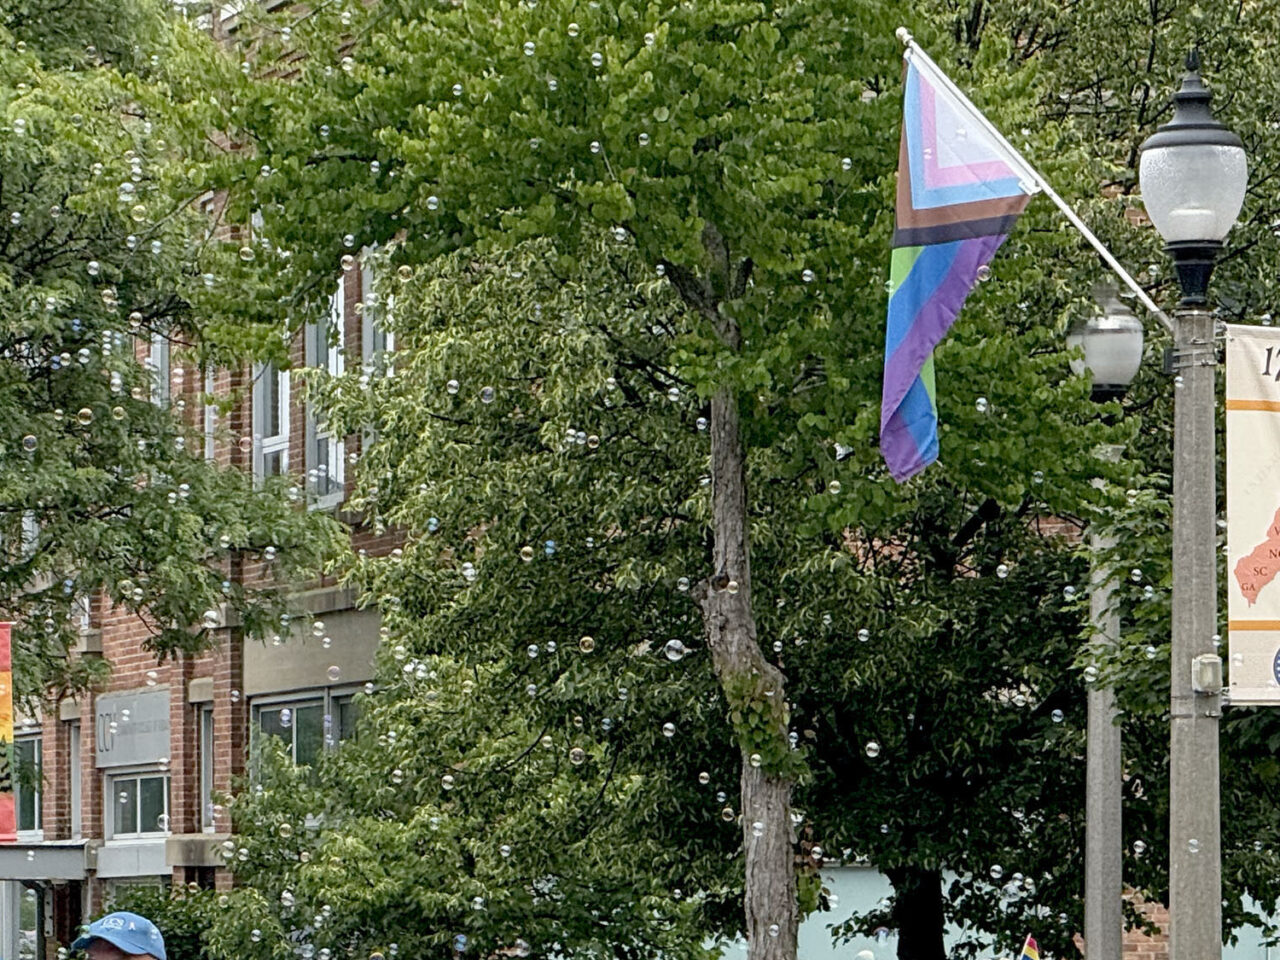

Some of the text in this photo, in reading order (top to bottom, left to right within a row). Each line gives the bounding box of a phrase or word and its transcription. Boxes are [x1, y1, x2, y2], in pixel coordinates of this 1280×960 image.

[1262, 346, 1280, 382] 1
[1253, 566, 1268, 577] SC
[1241, 582, 1255, 592] GA
